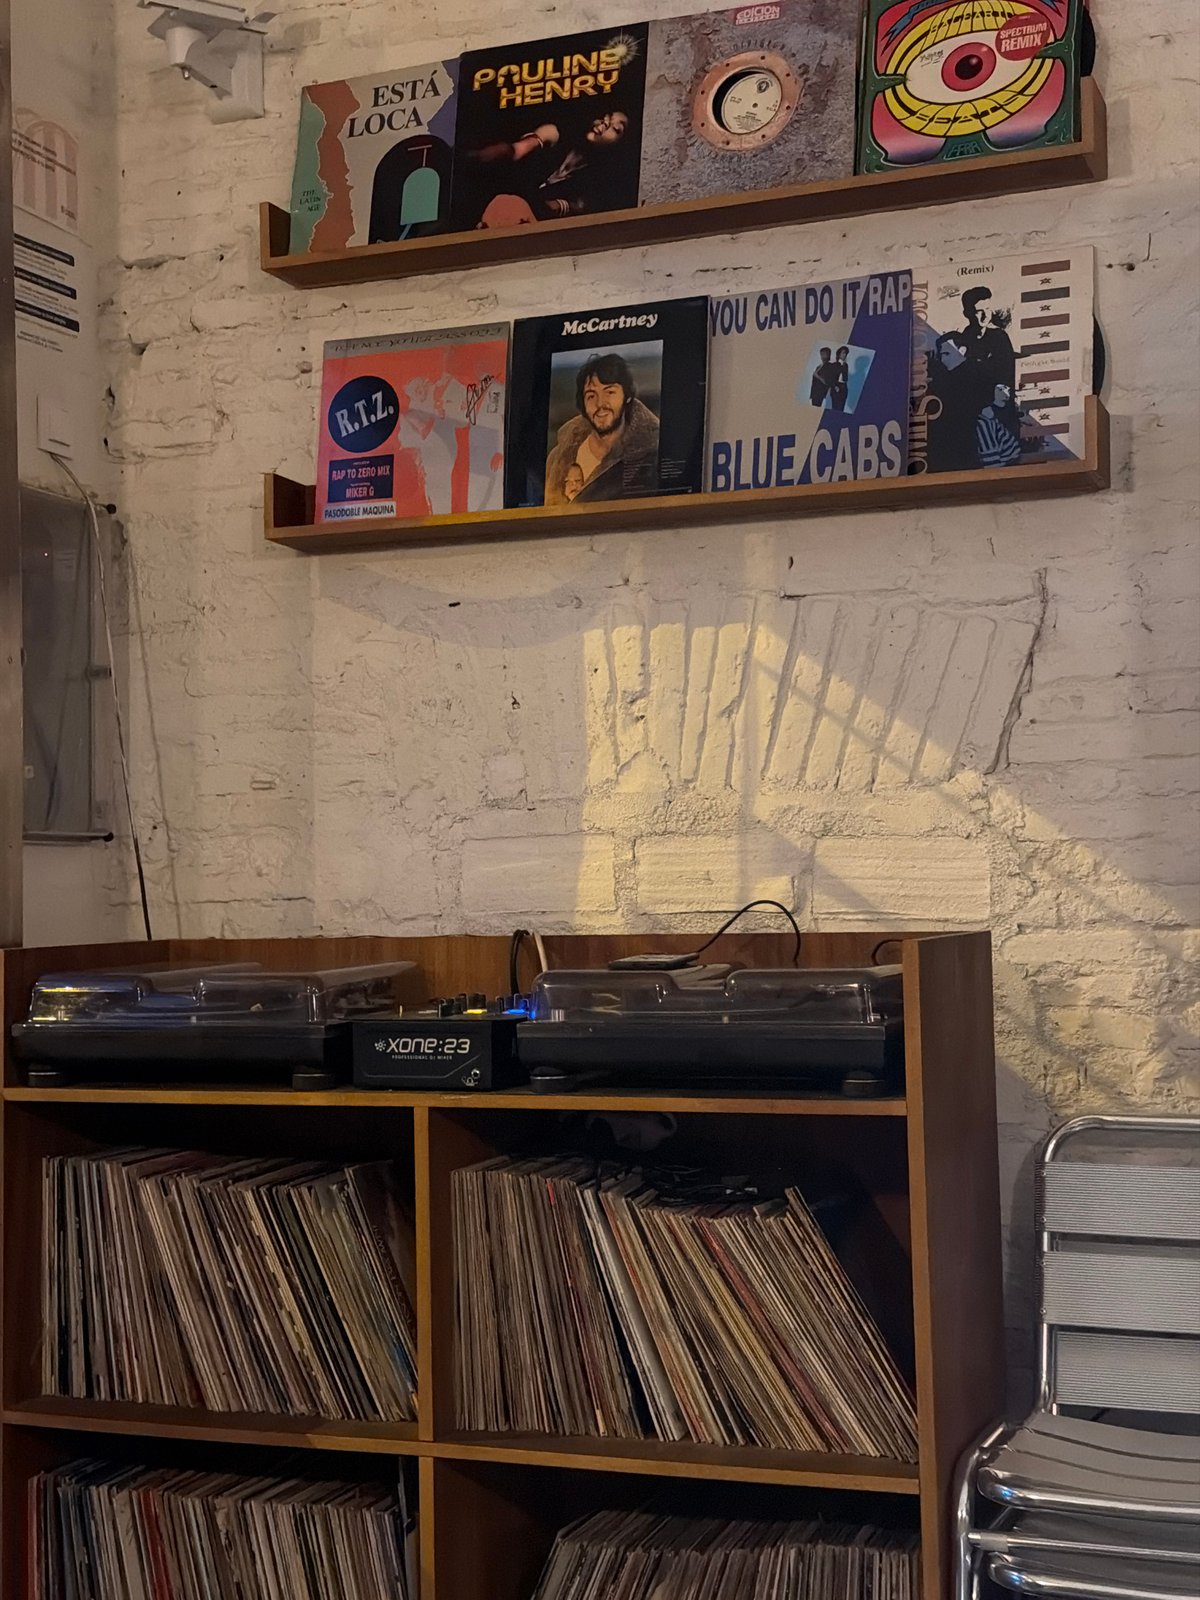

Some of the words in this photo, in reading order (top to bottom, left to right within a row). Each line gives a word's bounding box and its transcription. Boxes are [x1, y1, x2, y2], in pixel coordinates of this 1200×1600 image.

[1000, 23, 1047, 39] SPECTRUM
[1001, 33, 1042, 52] REMIX
[473, 49, 621, 91] PAULINE
[371, 70, 441, 108] ESTÁ
[498, 69, 620, 110] HENRY
[346, 106, 424, 139] LOCA
[956, 263, 994, 278] (Remix)
[711, 293, 747, 337] YOU
[755, 289, 797, 330] CAN
[805, 284, 834, 325] DO
[842, 281, 861, 320] IT
[868, 273, 912, 316] RAP
[562, 312, 658, 336] McCartney
[335, 390, 394, 438] R.T.Z.
[712, 434, 796, 492] BLUE
[809, 420, 902, 484] CABS
[332, 469, 346, 481] RAP
[346, 469, 357, 479] TO
[358, 467, 376, 478] ZERO
[377, 465, 391, 476] MIX
[345, 487, 369, 499] MIKER
[369, 486, 375, 496] G
[324, 506, 361, 519] PASODOBLE
[362, 504, 394, 516] MAQUINA
